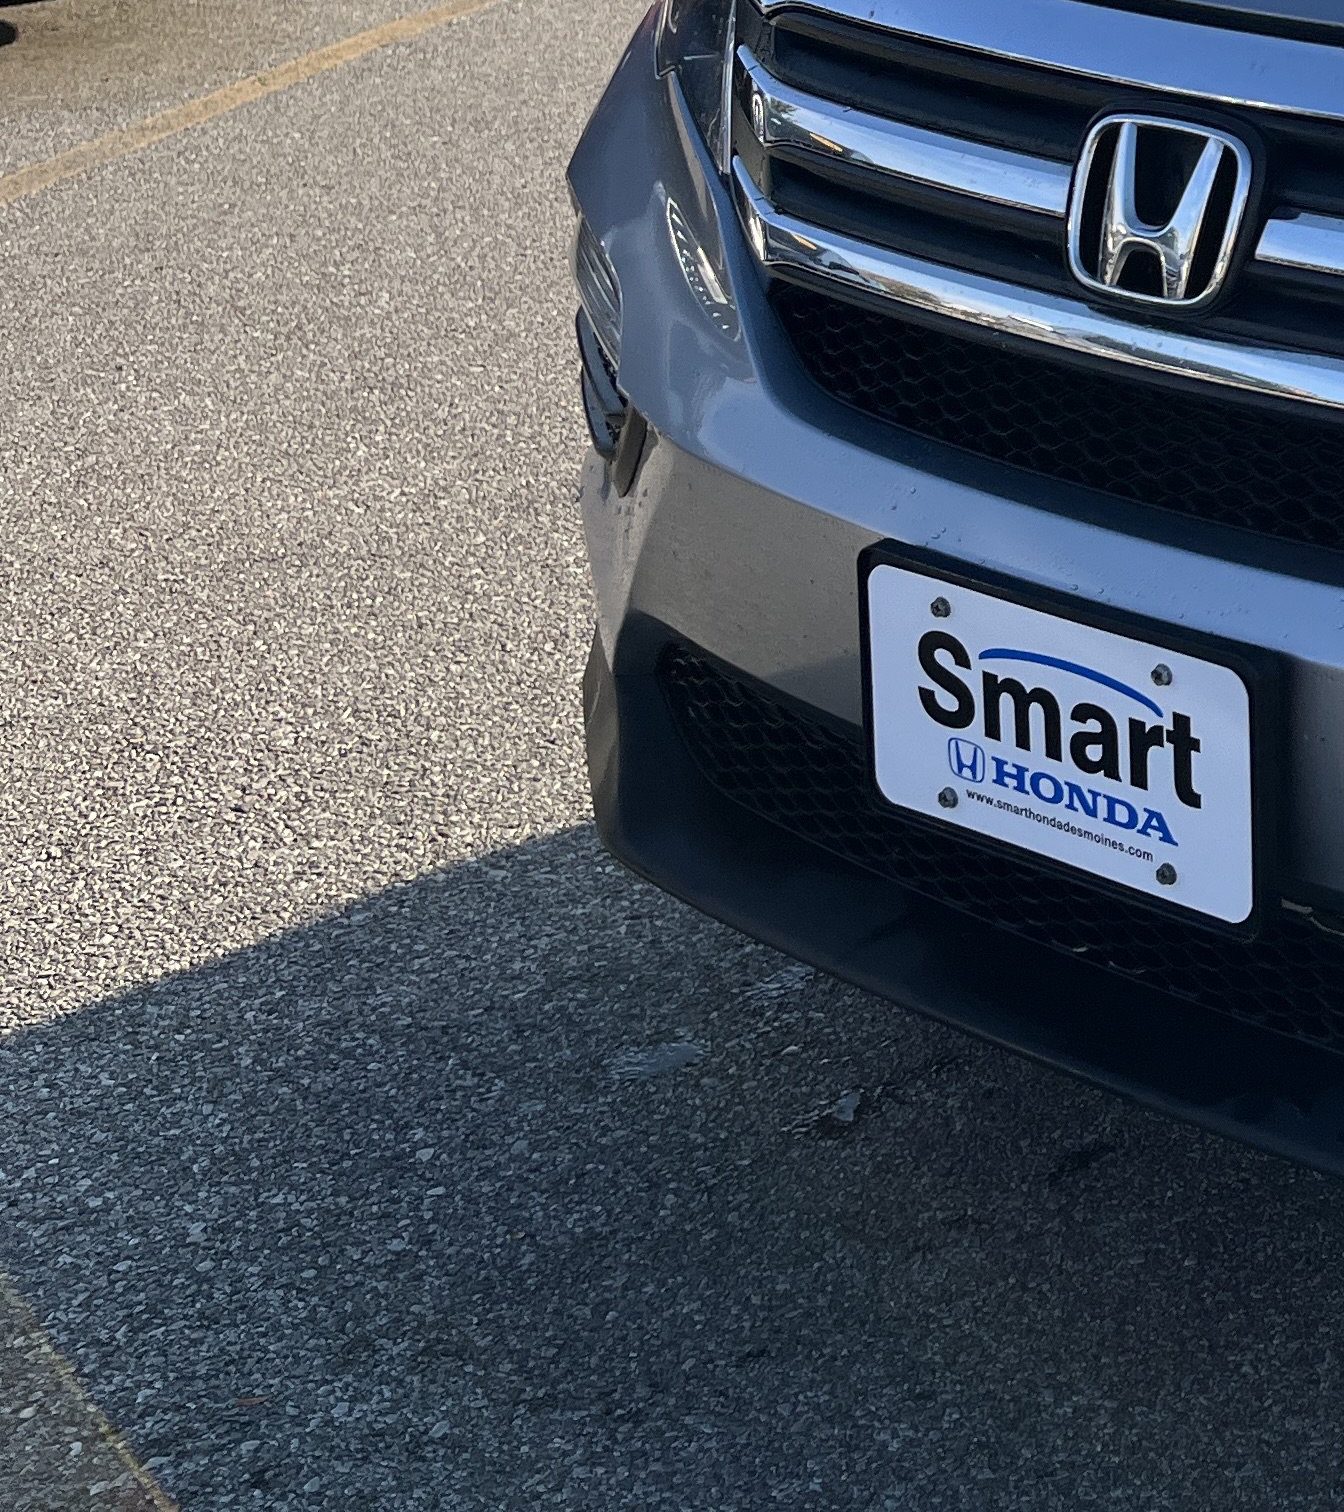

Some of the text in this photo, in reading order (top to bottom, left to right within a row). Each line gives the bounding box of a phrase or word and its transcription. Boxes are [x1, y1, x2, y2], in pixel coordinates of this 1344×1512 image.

[916, 629, 1203, 810] Smart
[965, 788, 1155, 863] www.smarthondadesmoines.com
[990, 755, 1179, 848] HONDA
